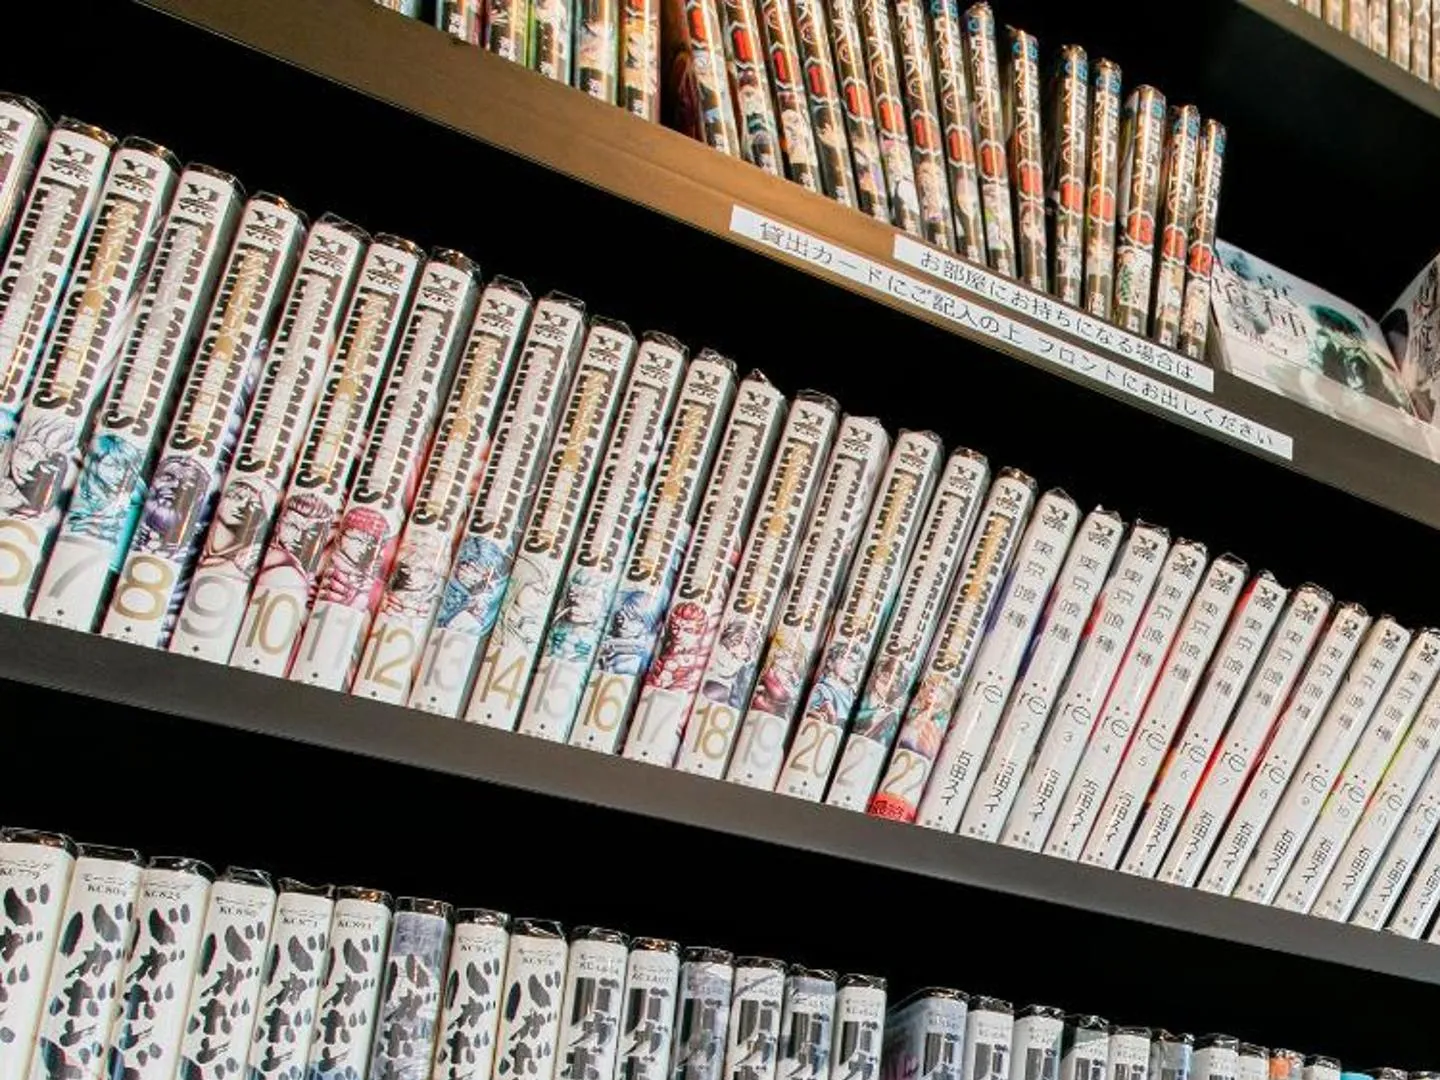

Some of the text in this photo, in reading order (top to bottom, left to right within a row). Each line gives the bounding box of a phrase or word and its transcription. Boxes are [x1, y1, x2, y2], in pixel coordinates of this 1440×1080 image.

[760, 222, 1274, 446] 貸出カードにご記入の上 フロントにお出しください
[921, 252, 1195, 379] お部屋にお持ちになる場合は
[49, 535, 110, 598] 7
[113, 554, 173, 621] 8
[180, 575, 236, 638] 9
[245, 588, 300, 655] 10
[364, 622, 415, 690] 12
[424, 630, 469, 693] 13
[479, 645, 527, 710] 14
[582, 673, 628, 731] 16
[636, 689, 687, 745] 17
[692, 704, 735, 759] 18
[741, 714, 783, 768] 19
[790, 720, 838, 778] 20
